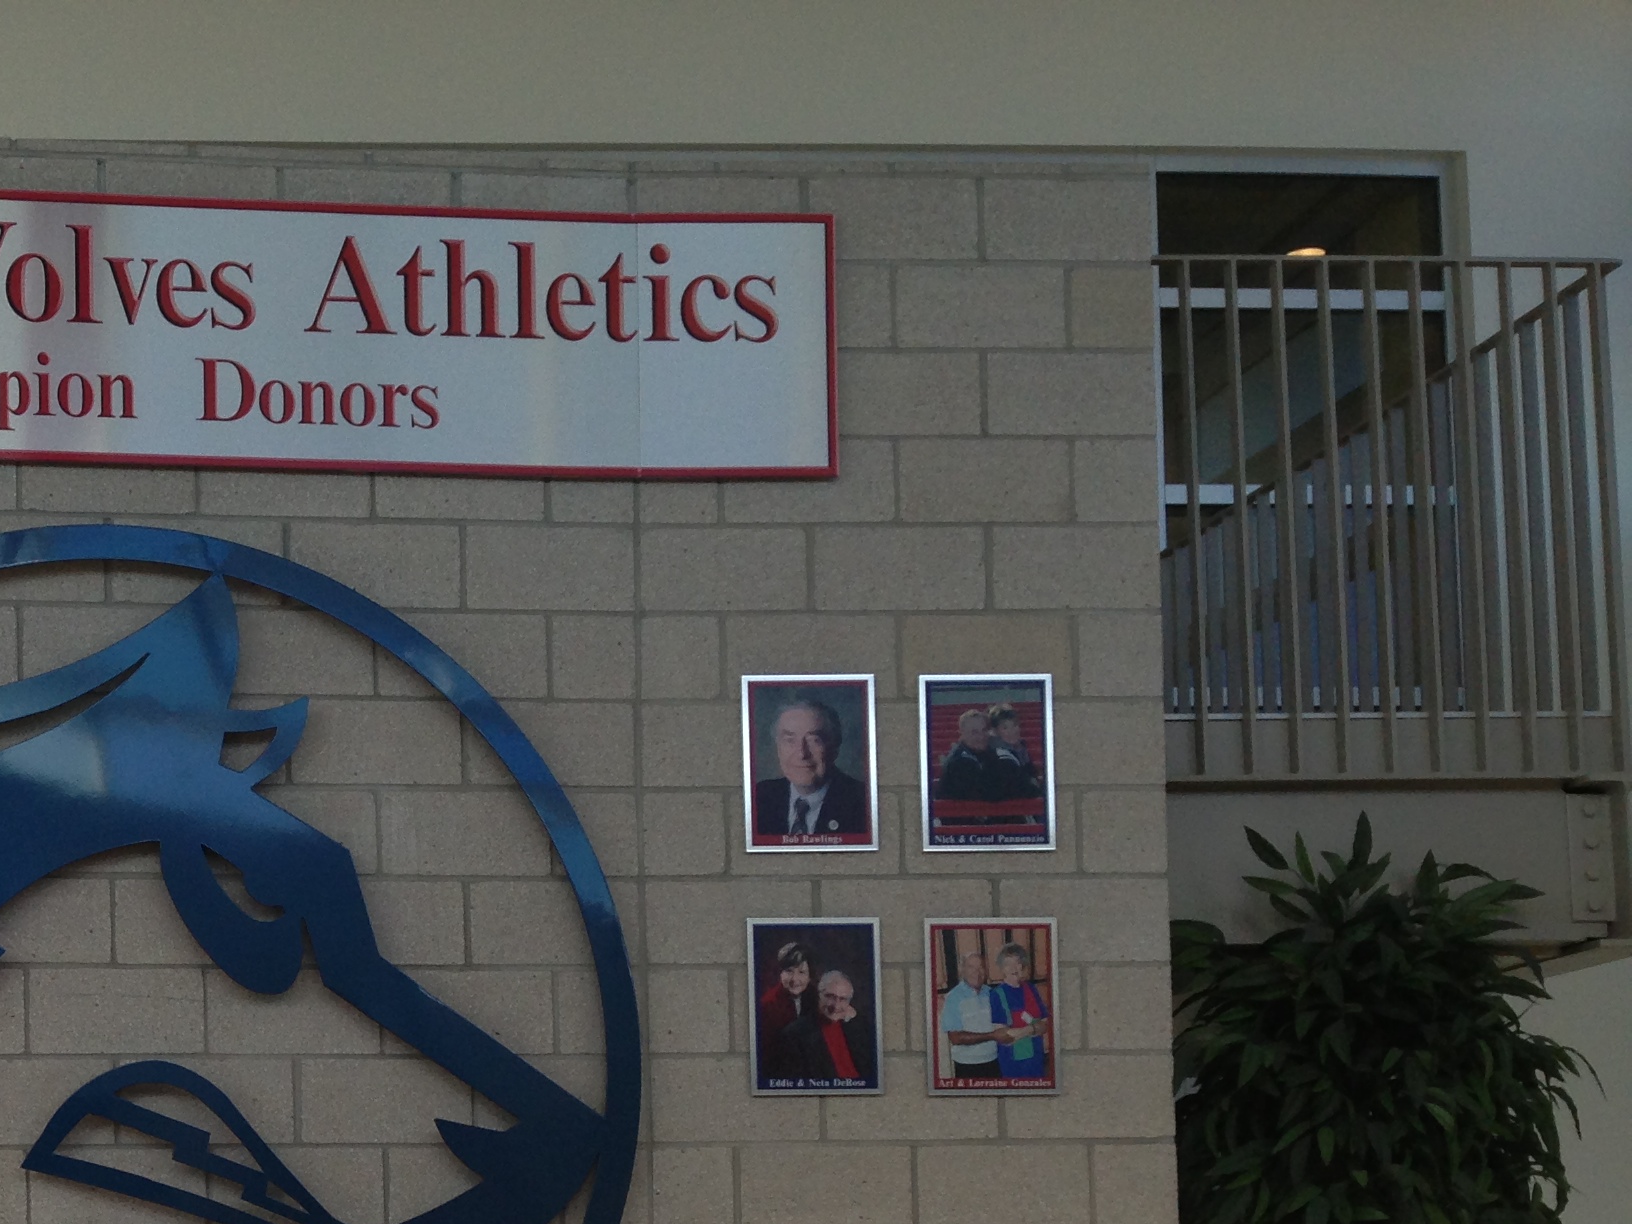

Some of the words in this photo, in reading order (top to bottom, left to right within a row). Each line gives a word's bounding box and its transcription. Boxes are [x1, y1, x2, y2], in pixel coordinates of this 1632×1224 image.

[305, 234, 780, 346] Athletics
[196, 357, 441, 432] Donors
[782, 834, 799, 844] Bob
[803, 834, 843, 845] Rawlings
[934, 834, 956, 844] Nick
[959, 835, 966, 844] &
[970, 834, 994, 843] Carol
[769, 1078, 794, 1088] Eddie
[797, 1079, 805, 1087] &
[833, 1078, 867, 1087] DeRose
[939, 1079, 954, 1088] Art
[957, 1079, 965, 1087] &
[969, 1078, 1008, 1087] Lorraine
[1011, 1078, 1052, 1087] Gonzales
